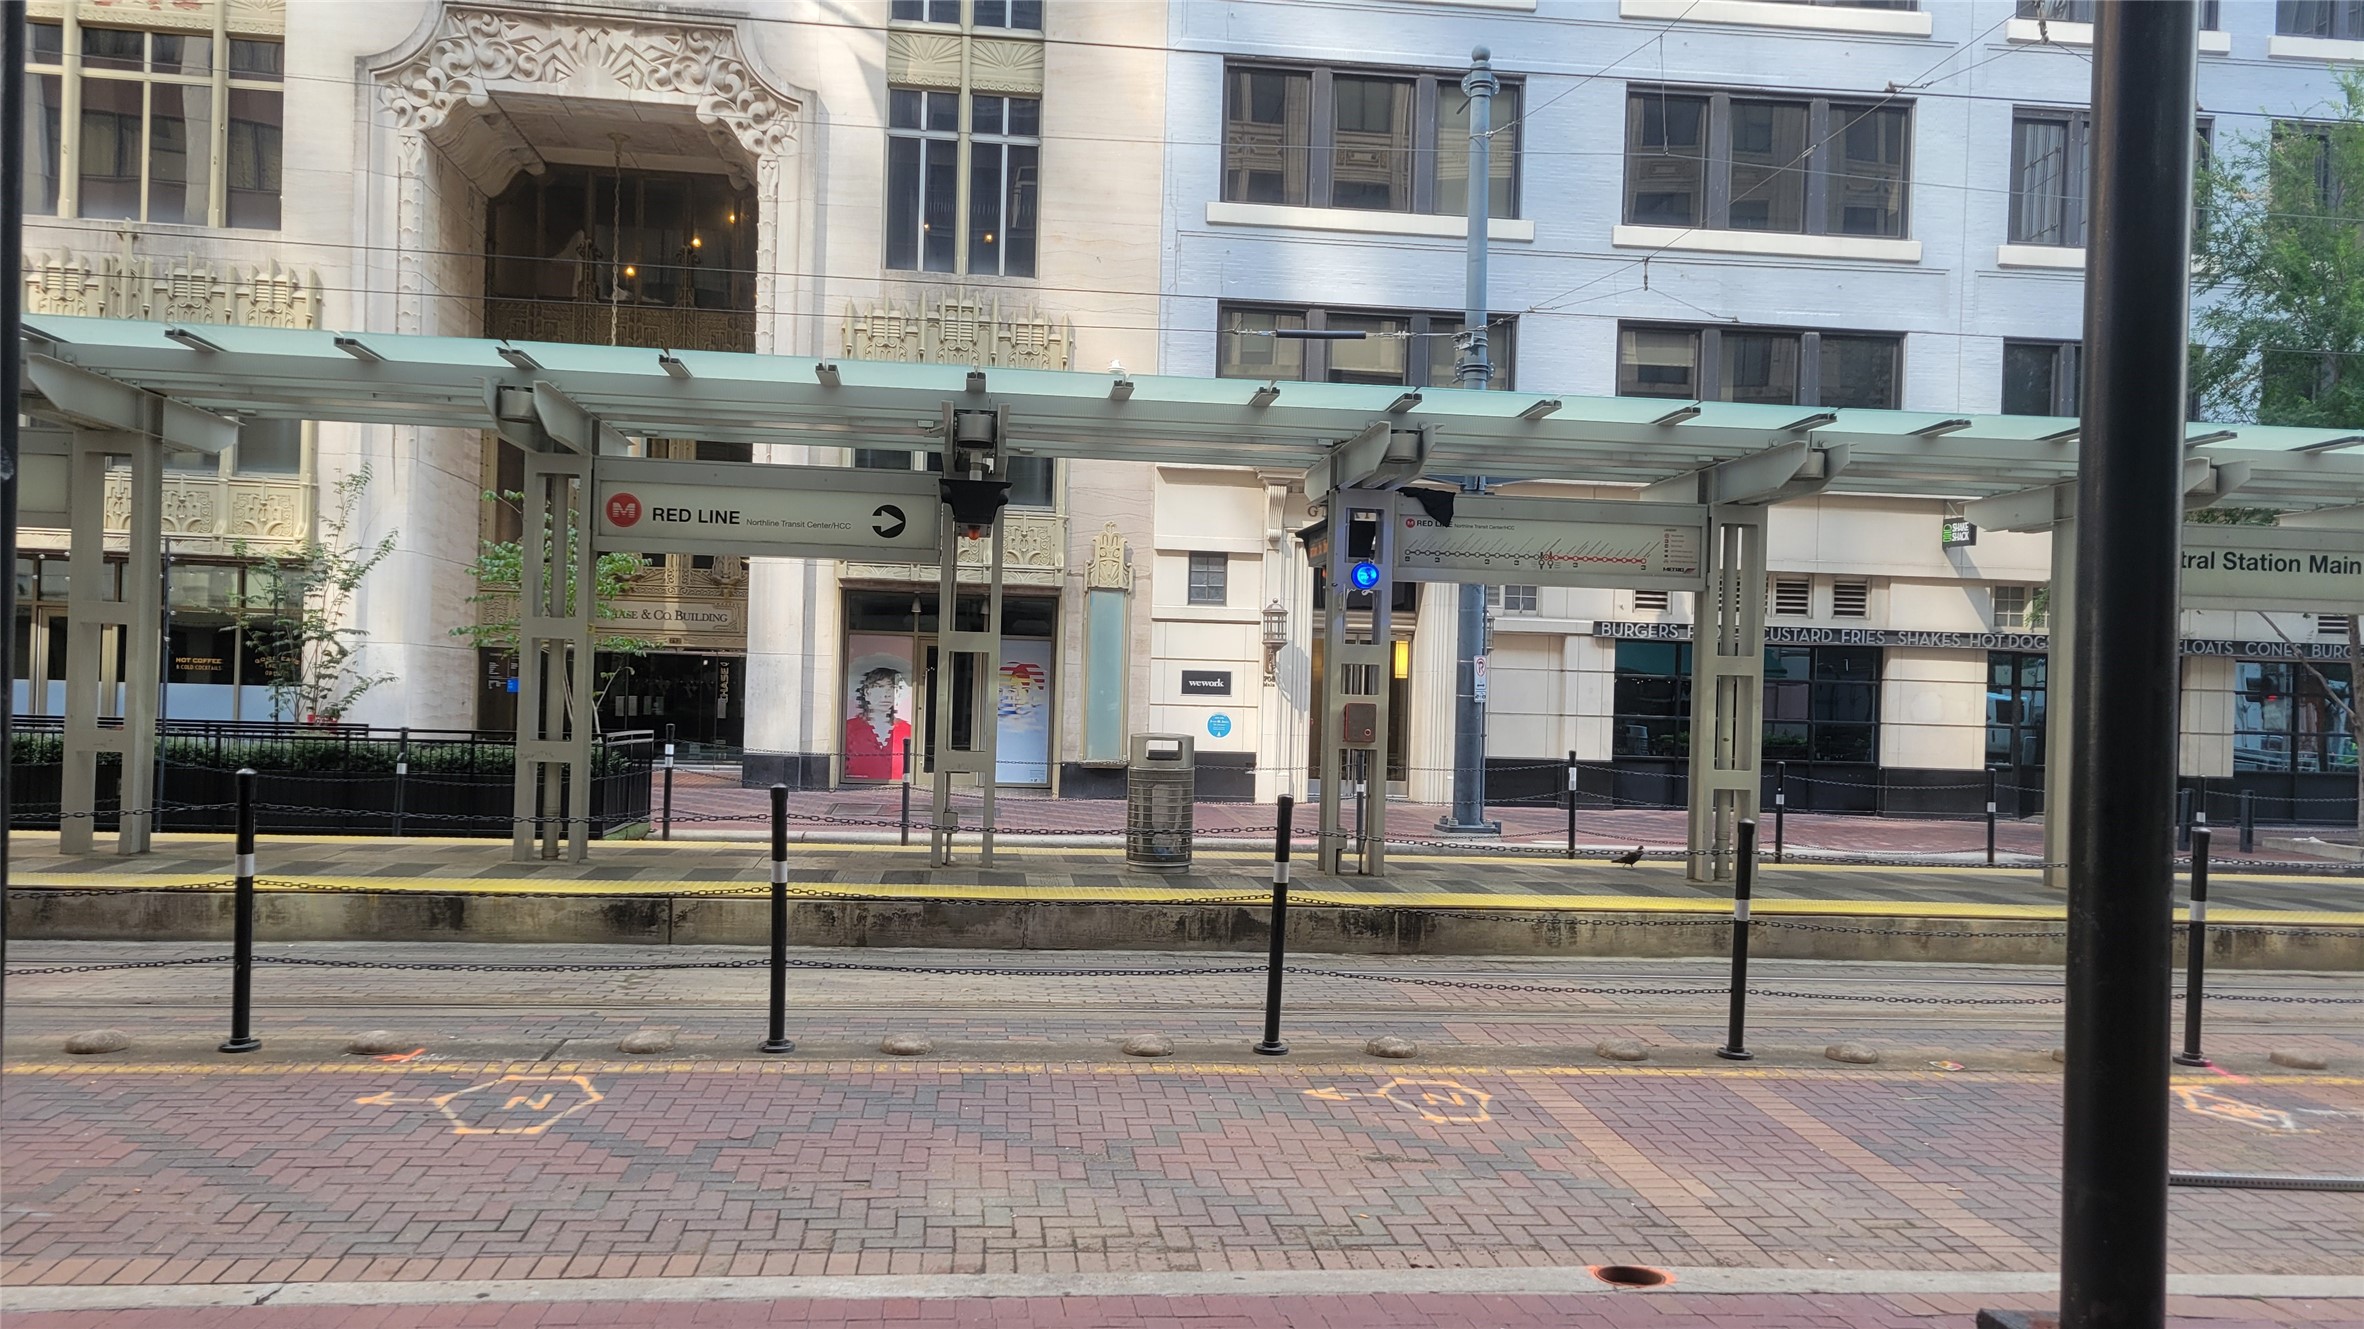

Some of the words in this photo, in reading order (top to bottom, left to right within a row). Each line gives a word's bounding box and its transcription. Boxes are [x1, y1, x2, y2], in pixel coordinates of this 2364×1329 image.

[652, 507, 691, 522] RED
[698, 509, 740, 525] LINE
[746, 518, 779, 528] Northline
[781, 519, 805, 529] Transit
[807, 521, 852, 530] Center/HCC
[1417, 519, 1433, 527] RED
[1952, 522, 1969, 532] SHAKE
[1952, 531, 1970, 541] SHACK
[2223, 551, 2301, 573] Station
[2309, 554, 2362, 575] Main
[641, 608, 652, 620] &
[1601, 622, 1679, 639] BURGERS
[1841, 629, 1886, 645] FRIES
[1897, 631, 1961, 647] SHAKES
[1969, 633, 2005, 648] HOT
[192, 657, 224, 665] COFFEE
[1188, 678, 1225, 688] wework
